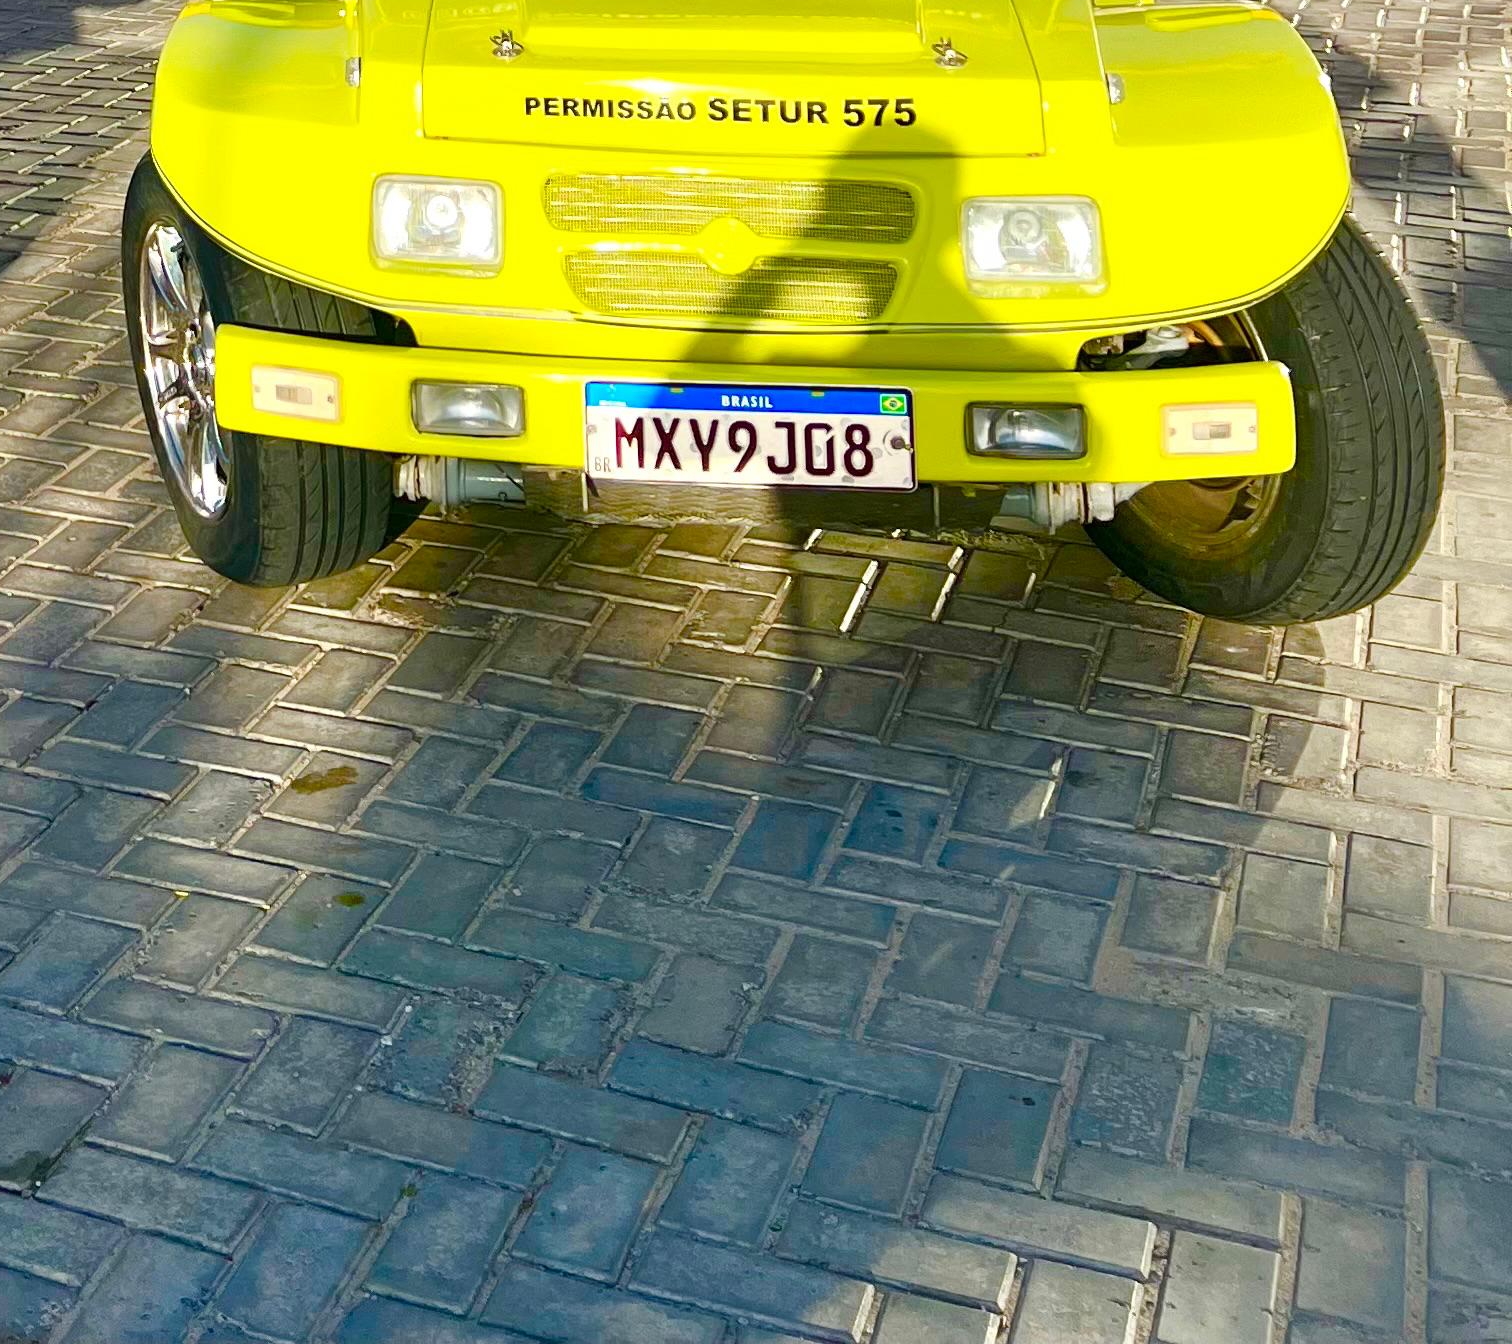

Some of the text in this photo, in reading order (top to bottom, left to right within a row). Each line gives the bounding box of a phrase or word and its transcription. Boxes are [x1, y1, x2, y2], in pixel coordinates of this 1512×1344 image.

[525, 97, 917, 127] PERMISSÃO SETUR 575
[721, 394, 774, 409] BRASIL
[615, 416, 876, 478] MXY9J08
[594, 456, 612, 473] BR
